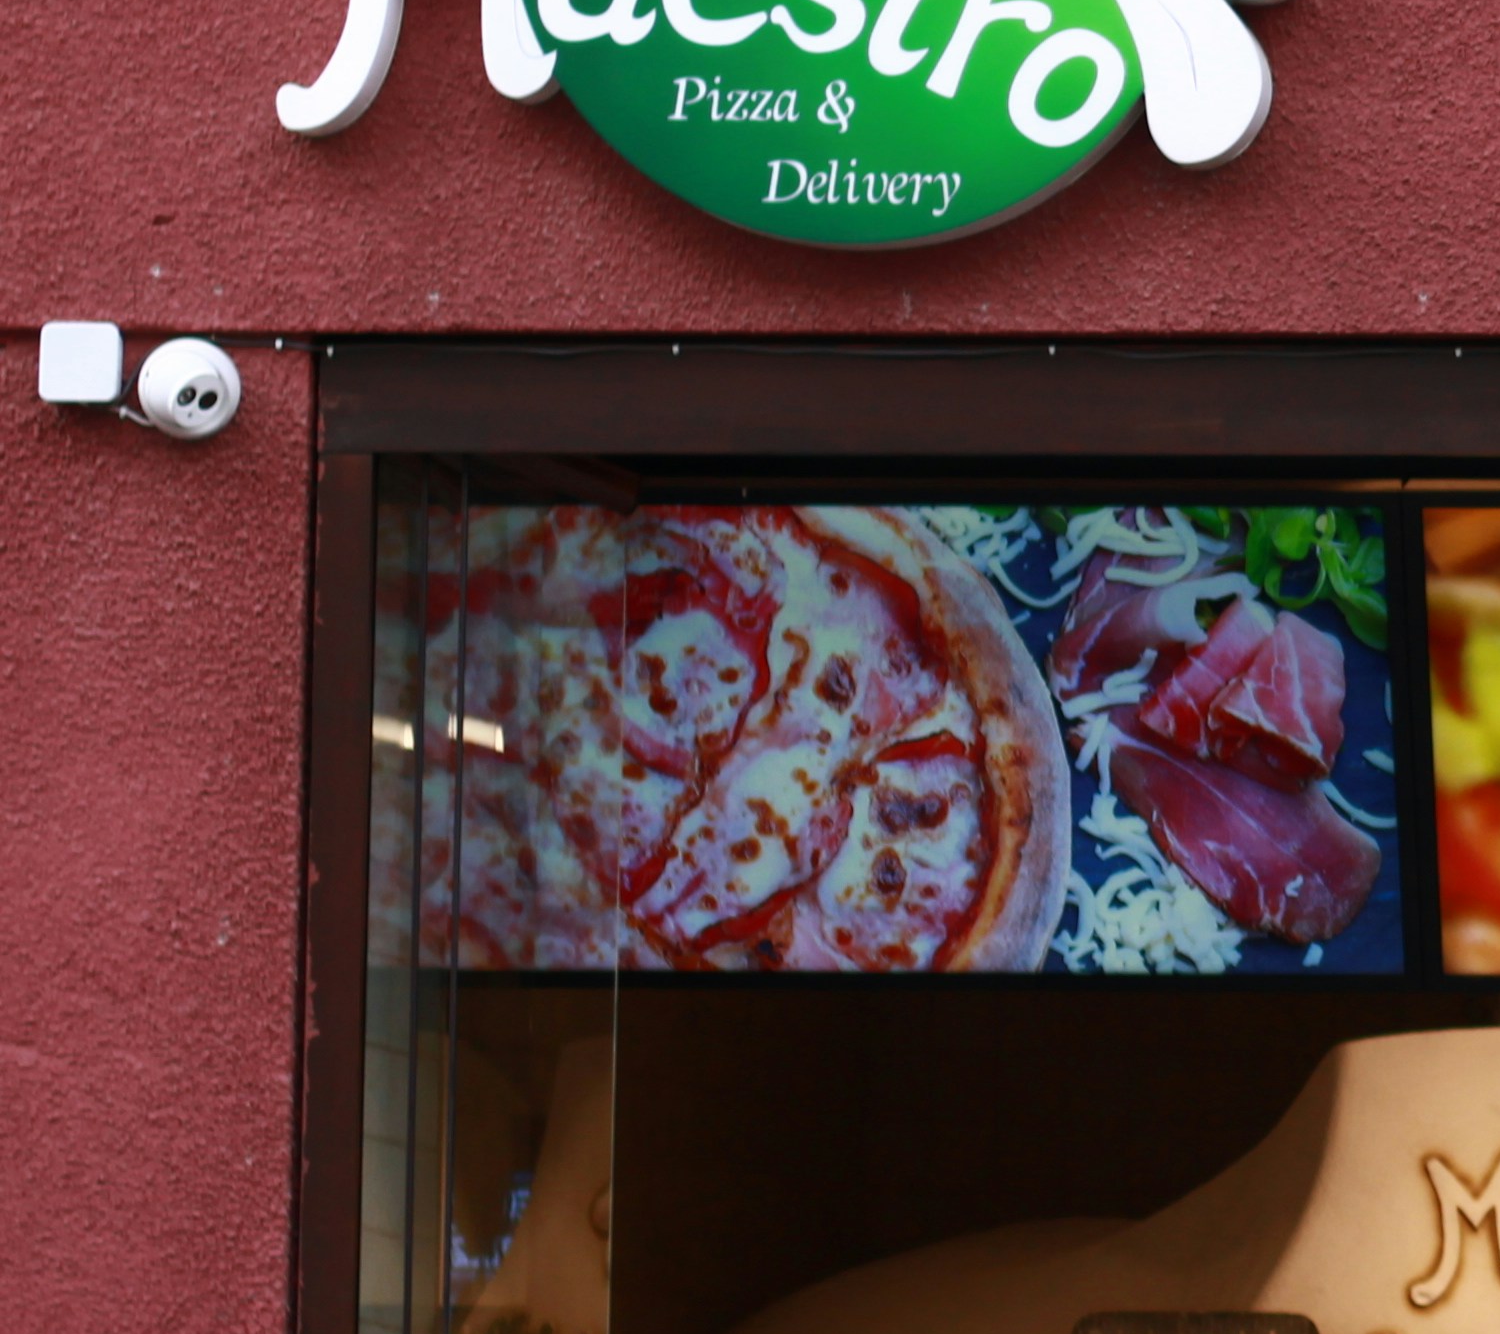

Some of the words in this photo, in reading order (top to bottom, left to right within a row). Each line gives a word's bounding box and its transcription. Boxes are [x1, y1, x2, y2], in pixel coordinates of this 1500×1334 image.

[667, 75, 799, 122] Pizza
[816, 79, 856, 133] &
[761, 158, 961, 217] Delivery
